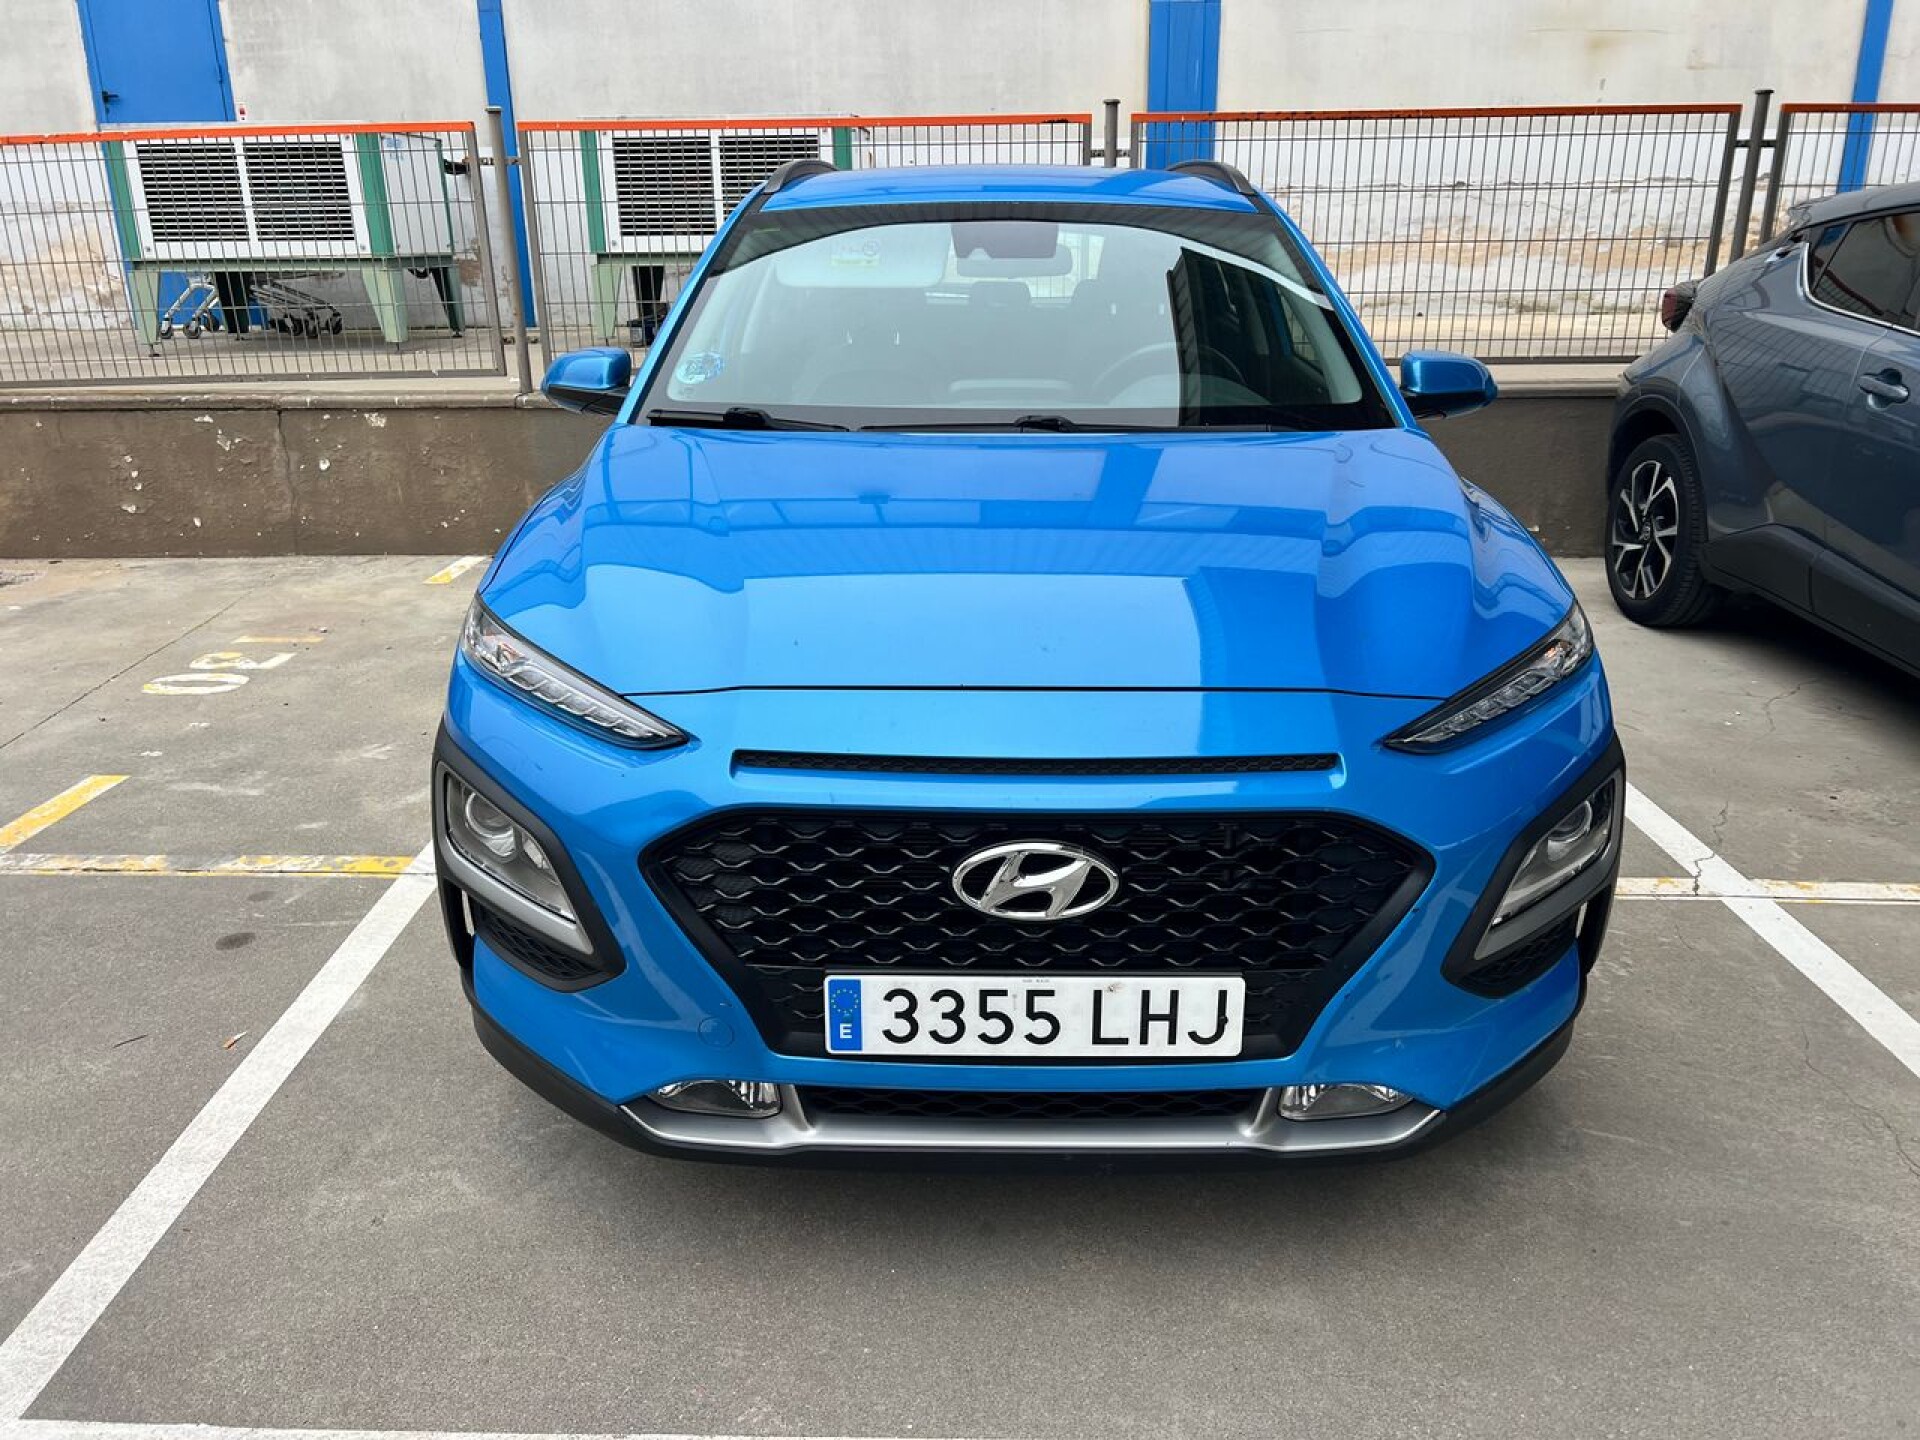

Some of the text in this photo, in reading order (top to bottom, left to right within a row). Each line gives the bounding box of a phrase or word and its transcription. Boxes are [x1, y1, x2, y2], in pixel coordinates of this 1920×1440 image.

[839, 1023, 853, 1039] E
[882, 988, 1228, 1045] 3355 LHJ
